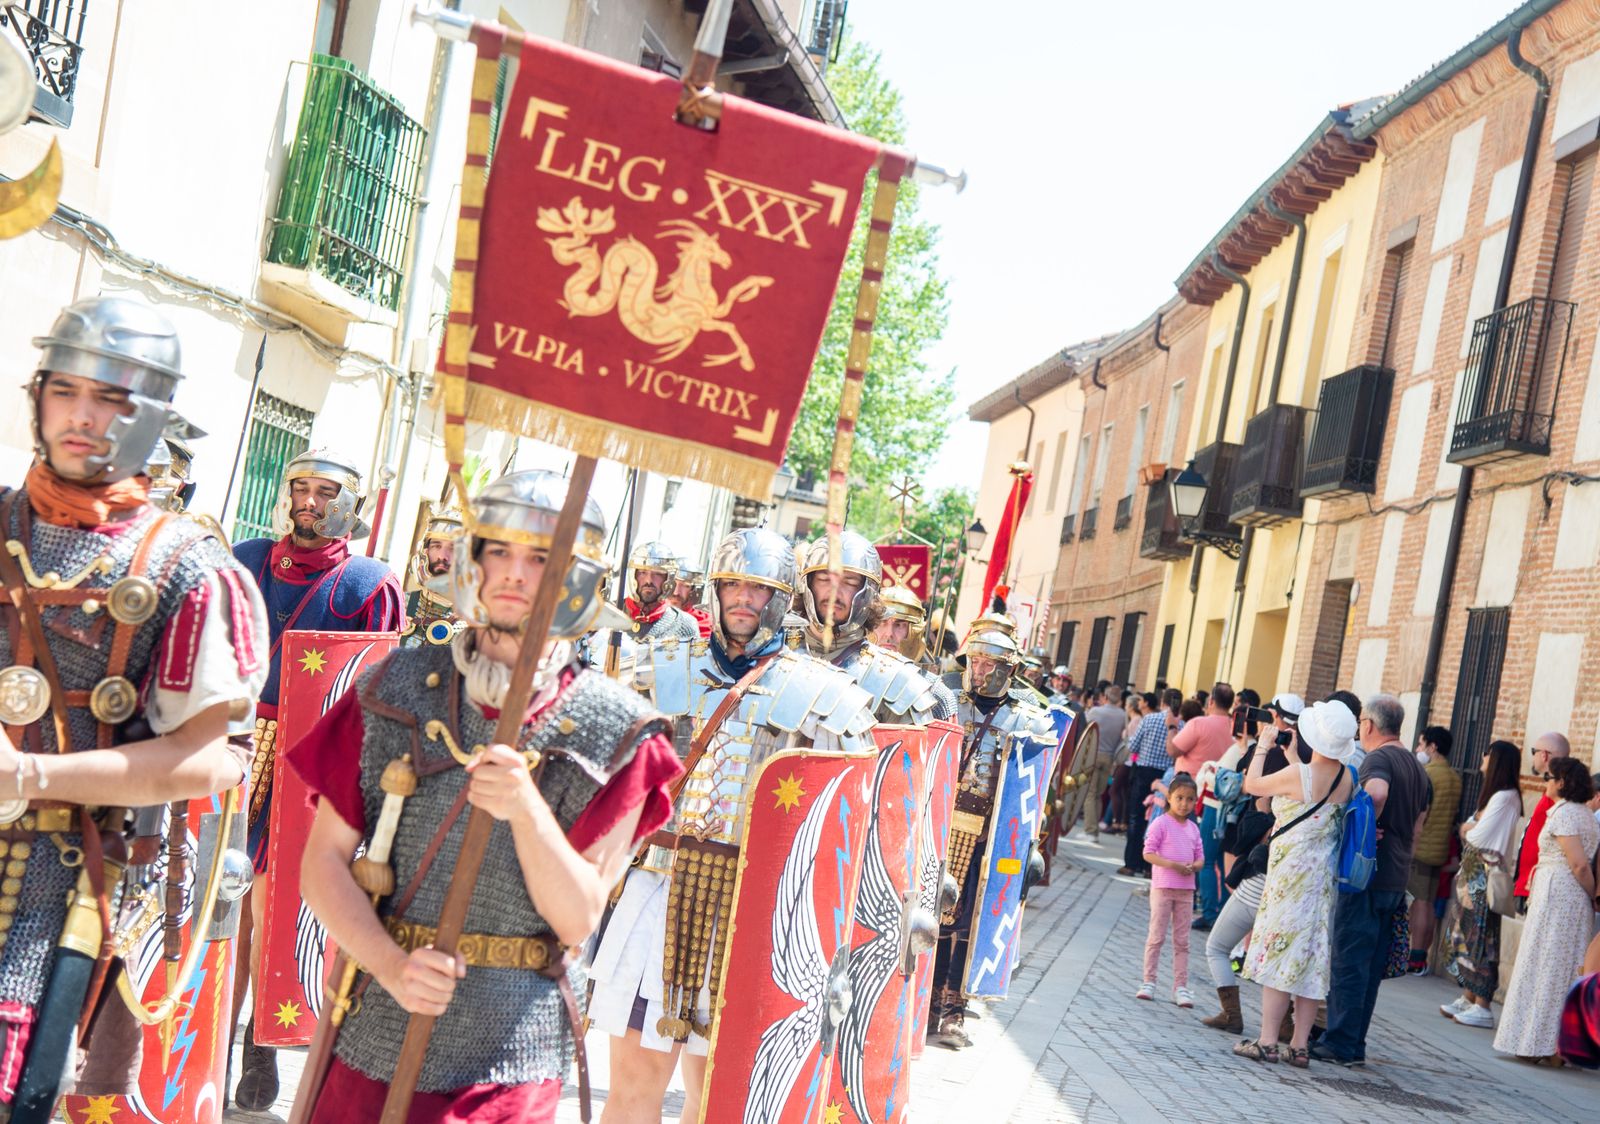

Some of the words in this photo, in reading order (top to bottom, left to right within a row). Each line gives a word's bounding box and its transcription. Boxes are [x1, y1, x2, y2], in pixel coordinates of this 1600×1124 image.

[535, 127, 666, 202] LEG
[693, 170, 822, 249] XXX
[493, 321, 585, 375] VLPIA
[623, 359, 759, 421] VICTRIX
